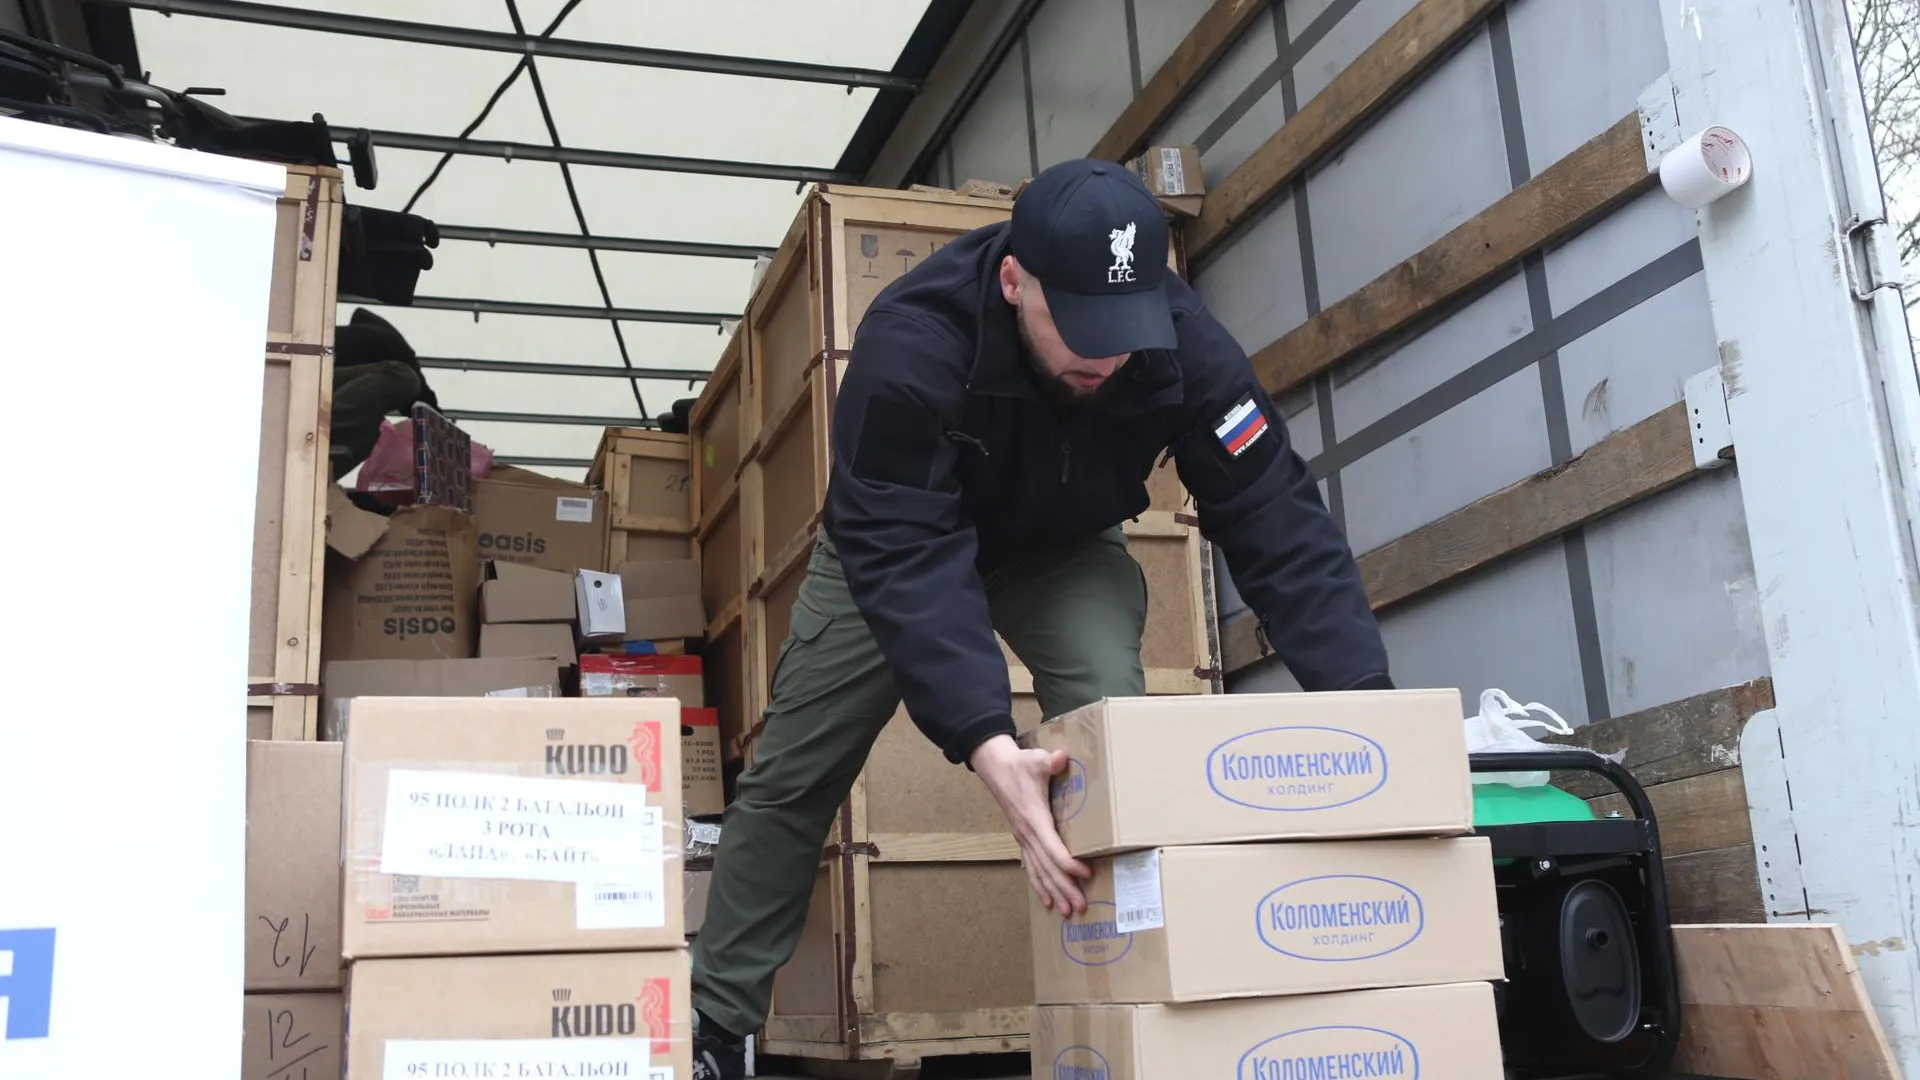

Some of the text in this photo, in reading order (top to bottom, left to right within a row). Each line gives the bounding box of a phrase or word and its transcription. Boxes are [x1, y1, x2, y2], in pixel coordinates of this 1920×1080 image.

[478, 532, 546, 554] oasis
[384, 617, 455, 640] oasis
[545, 744, 628, 775] KUDO
[1222, 745, 1373, 781] КОЛОМЕНСКИЙ
[409, 791, 625, 819] 95 ПОЛК 2 БАТАЛЬОН
[482, 820, 550, 838] 3 РОТА
[1270, 894, 1410, 931] КОЛОМЕНСКИЙ
[268, 1009, 311, 1060] 12
[552, 1003, 636, 1038] KUDO
[407, 1061, 628, 1078] 95 ПОЛК 2 БАТАЛЬОН
